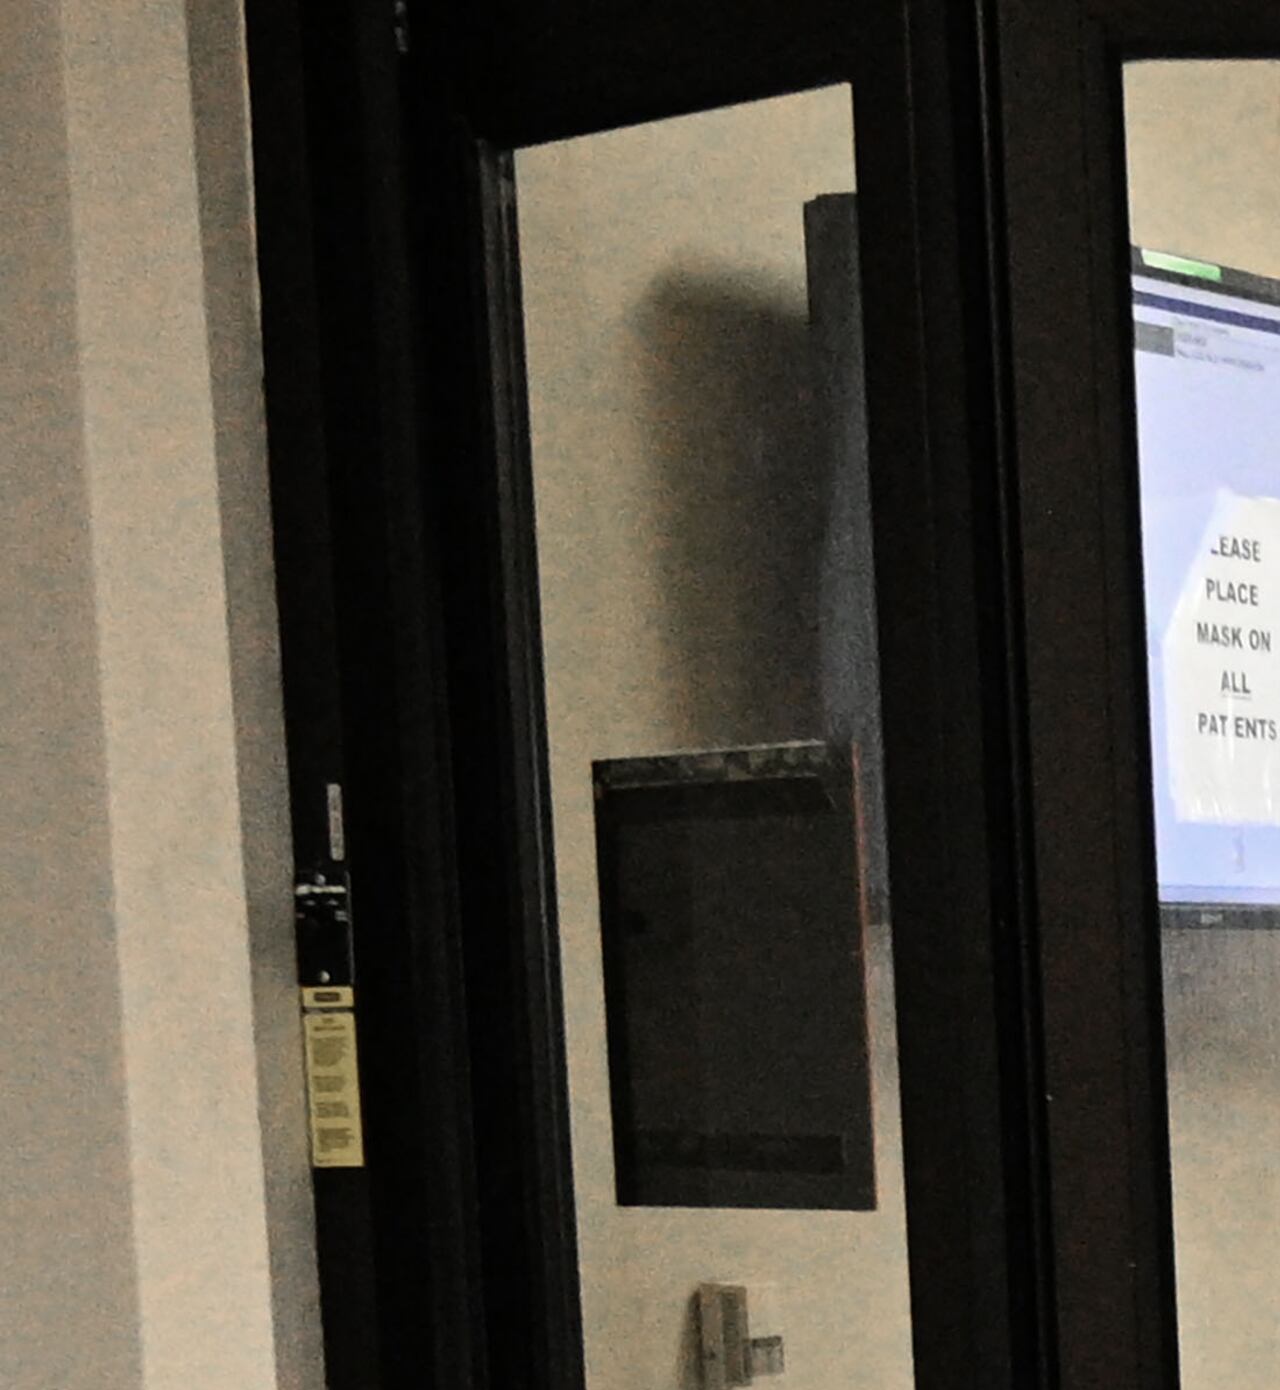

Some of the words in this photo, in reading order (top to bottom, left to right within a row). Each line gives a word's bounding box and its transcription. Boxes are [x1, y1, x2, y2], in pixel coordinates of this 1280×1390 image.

[1210, 536, 1261, 562] EASE
[1205, 578, 1258, 607] PLACE
[1197, 621, 1243, 649] MASK
[1248, 628, 1271, 652] ON
[1221, 670, 1251, 694] ALL
[1198, 712, 1278, 740] PATENTS
